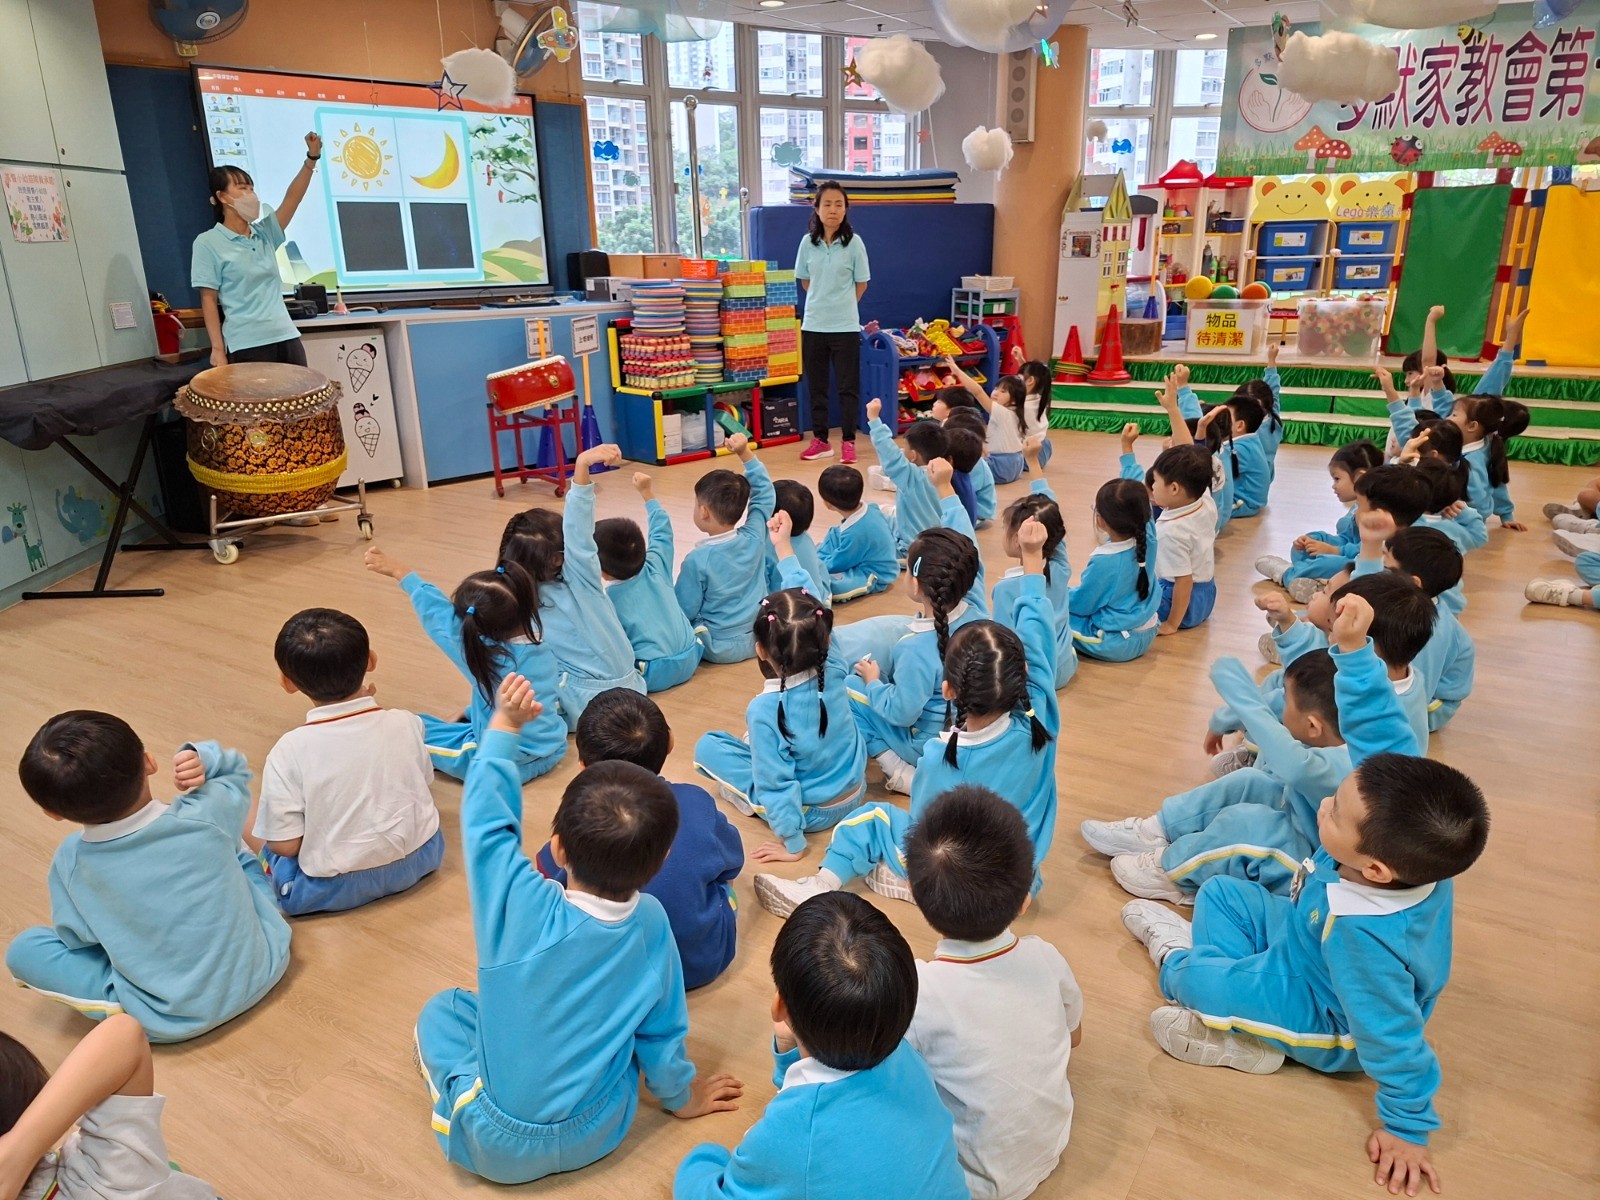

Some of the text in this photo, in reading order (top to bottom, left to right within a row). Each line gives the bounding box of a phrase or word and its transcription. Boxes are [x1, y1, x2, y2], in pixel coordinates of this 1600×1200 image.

[1206, 313, 1237, 328] 物品
[1196, 331, 1244, 346] 待清潔
